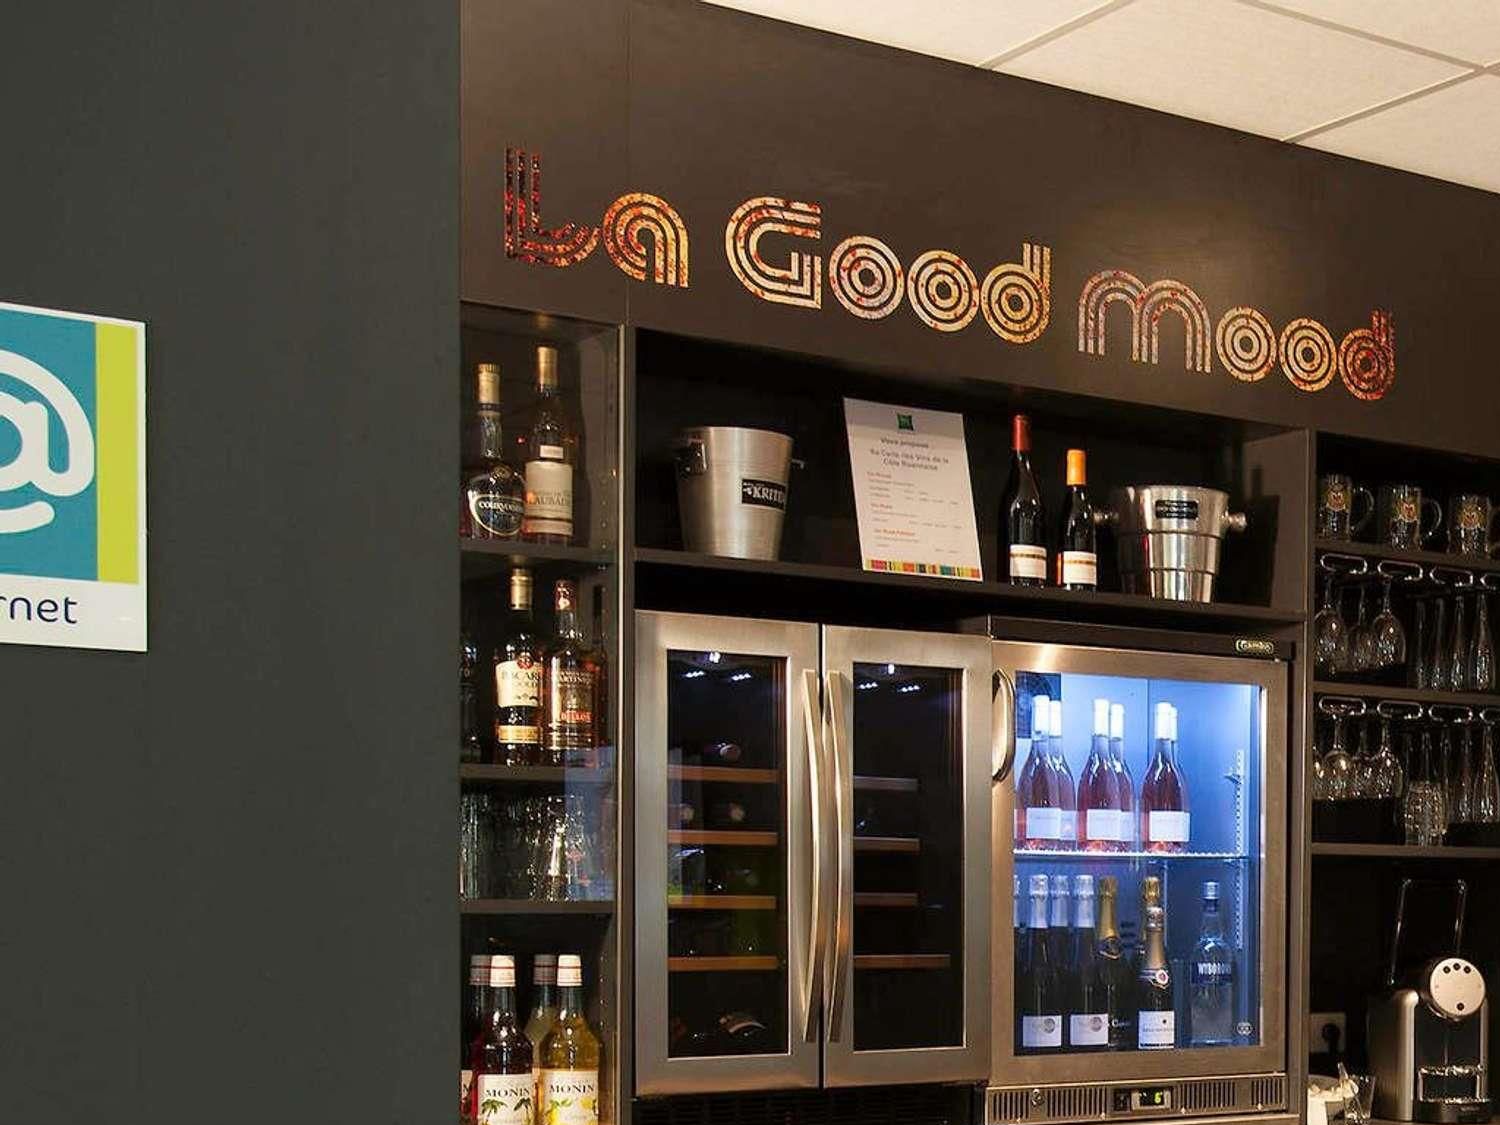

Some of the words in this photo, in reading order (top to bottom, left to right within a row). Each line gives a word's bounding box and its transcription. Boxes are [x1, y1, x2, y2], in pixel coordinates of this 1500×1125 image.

[505, 145, 689, 288] La
[725, 196, 1052, 344] Good
[486, 1087, 530, 1097] MONIN
[549, 1084, 594, 1094] MONIN
